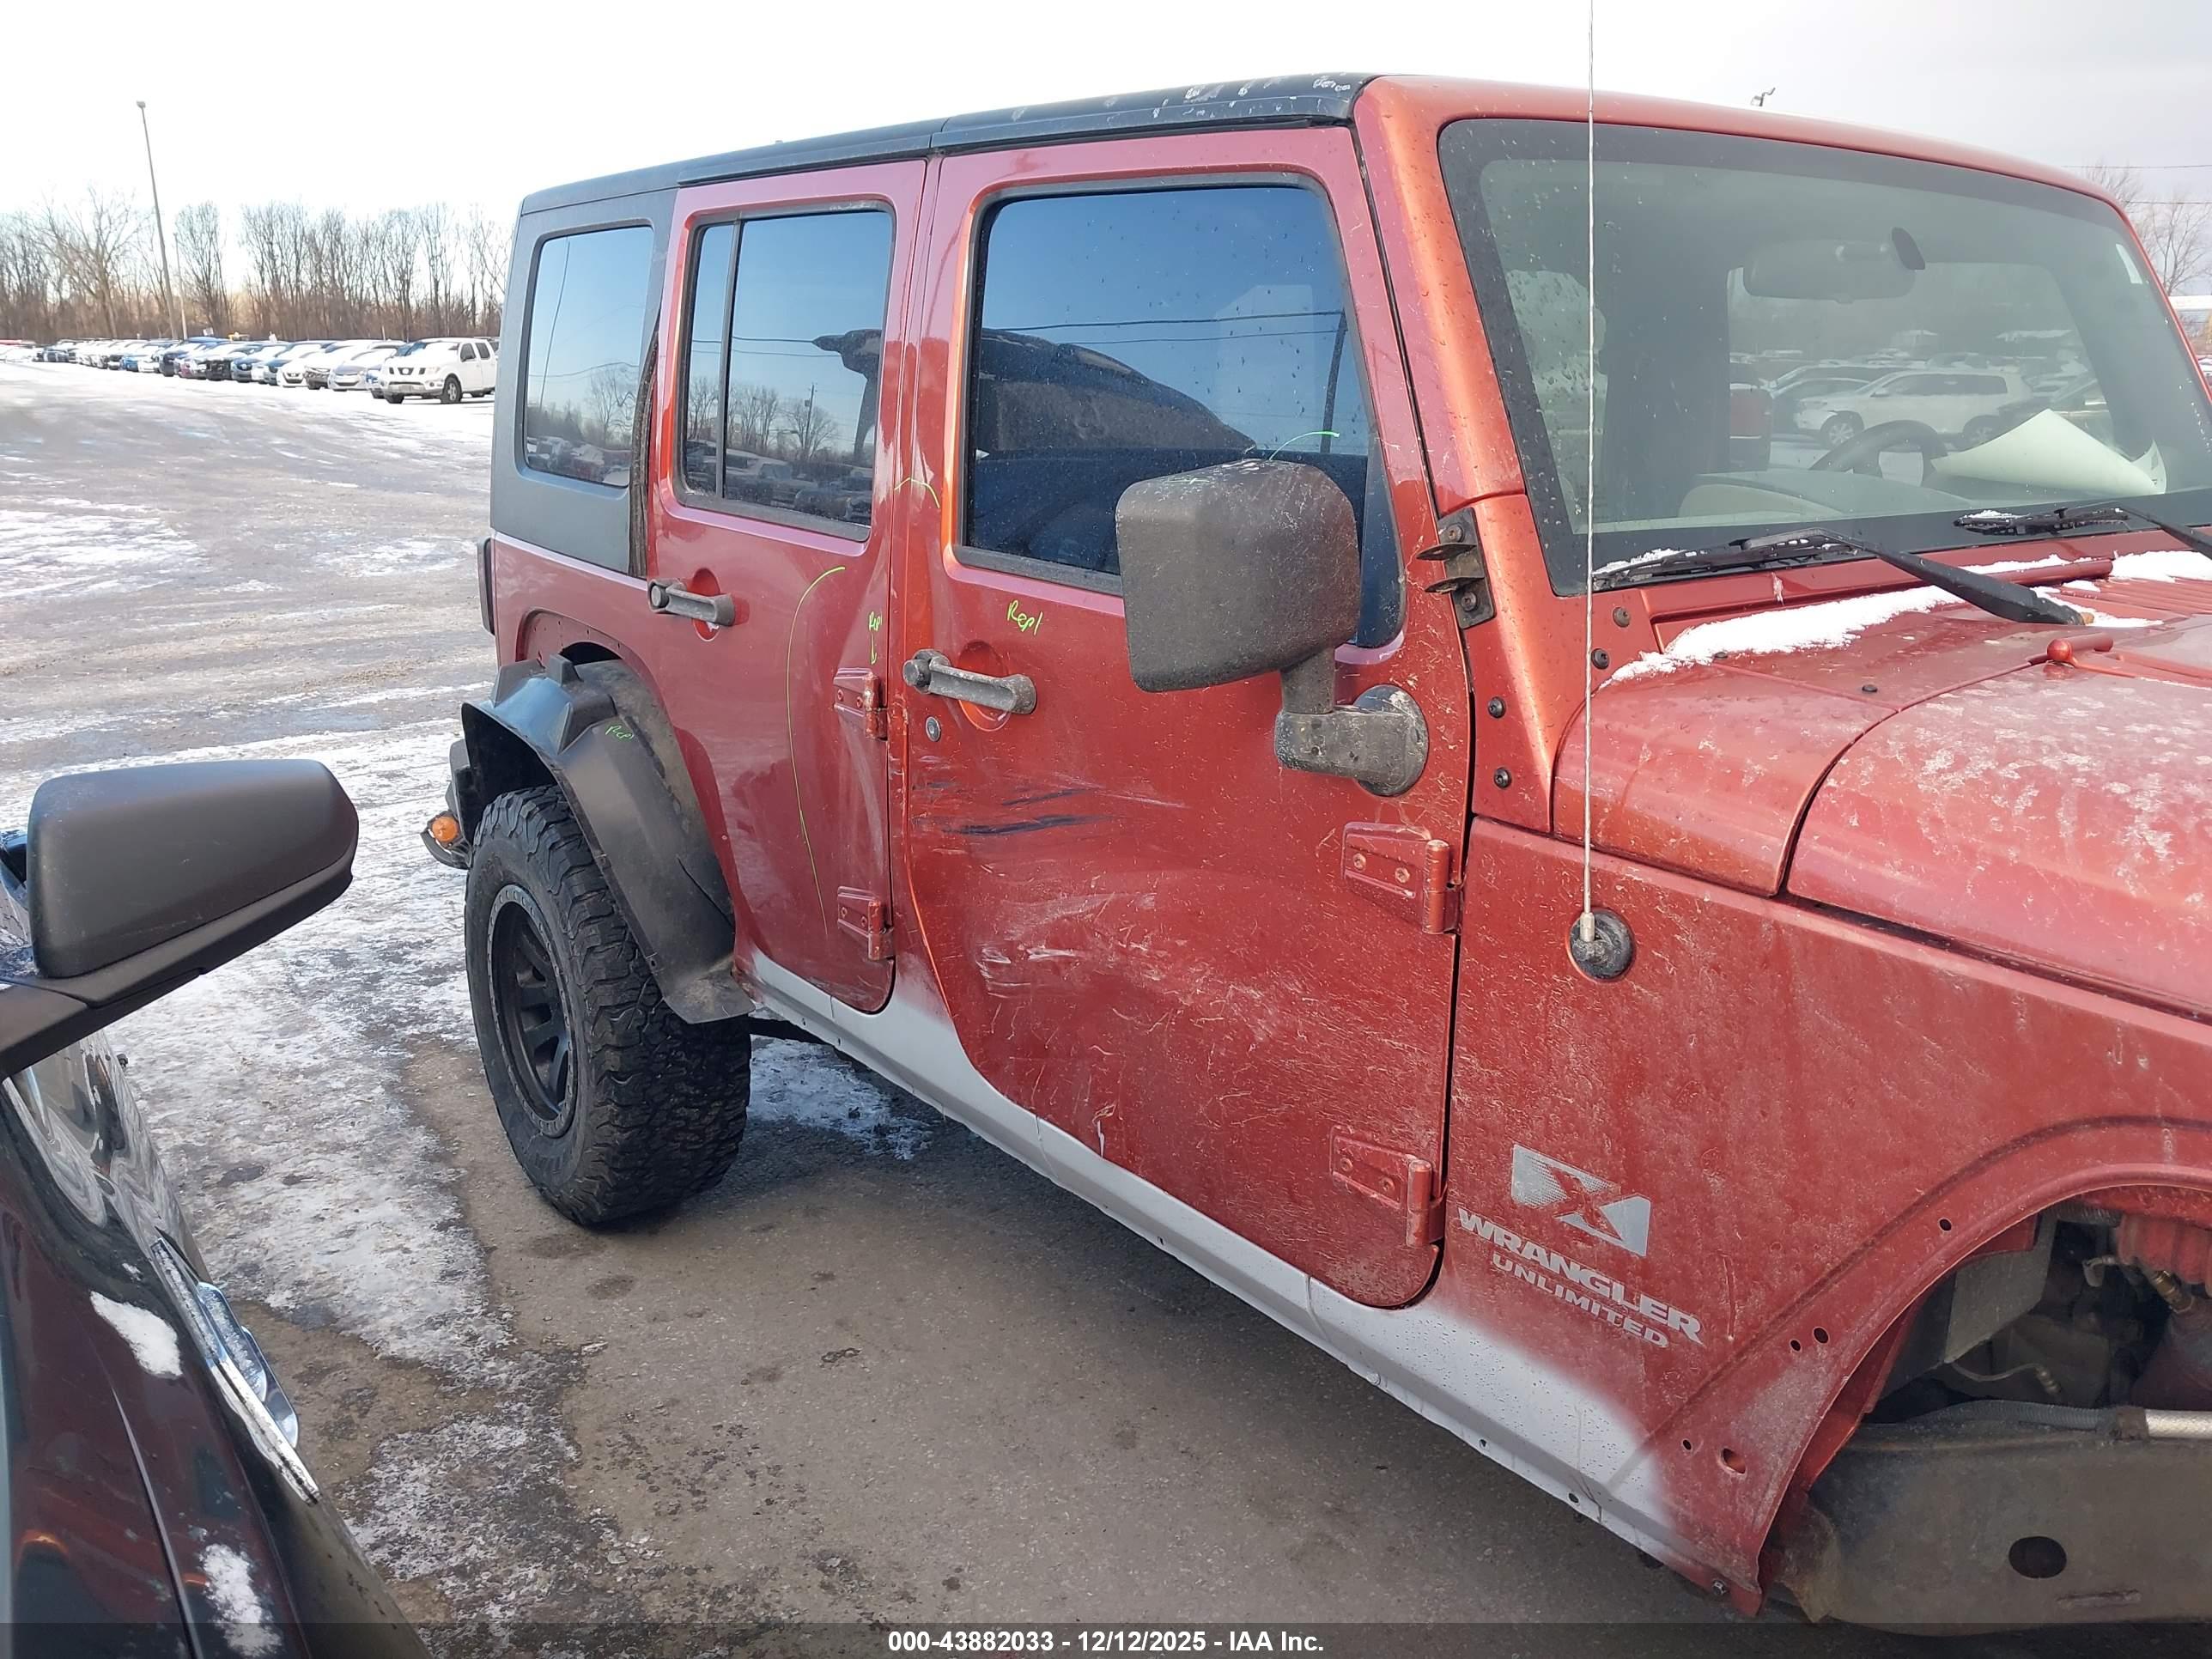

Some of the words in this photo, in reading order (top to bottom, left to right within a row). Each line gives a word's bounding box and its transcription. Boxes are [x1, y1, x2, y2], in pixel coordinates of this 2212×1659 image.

[1006, 599, 1043, 635] Repl
[1457, 1206, 1707, 1348] WRANGLER
[1492, 1251, 1669, 1348] UNLIMITED
